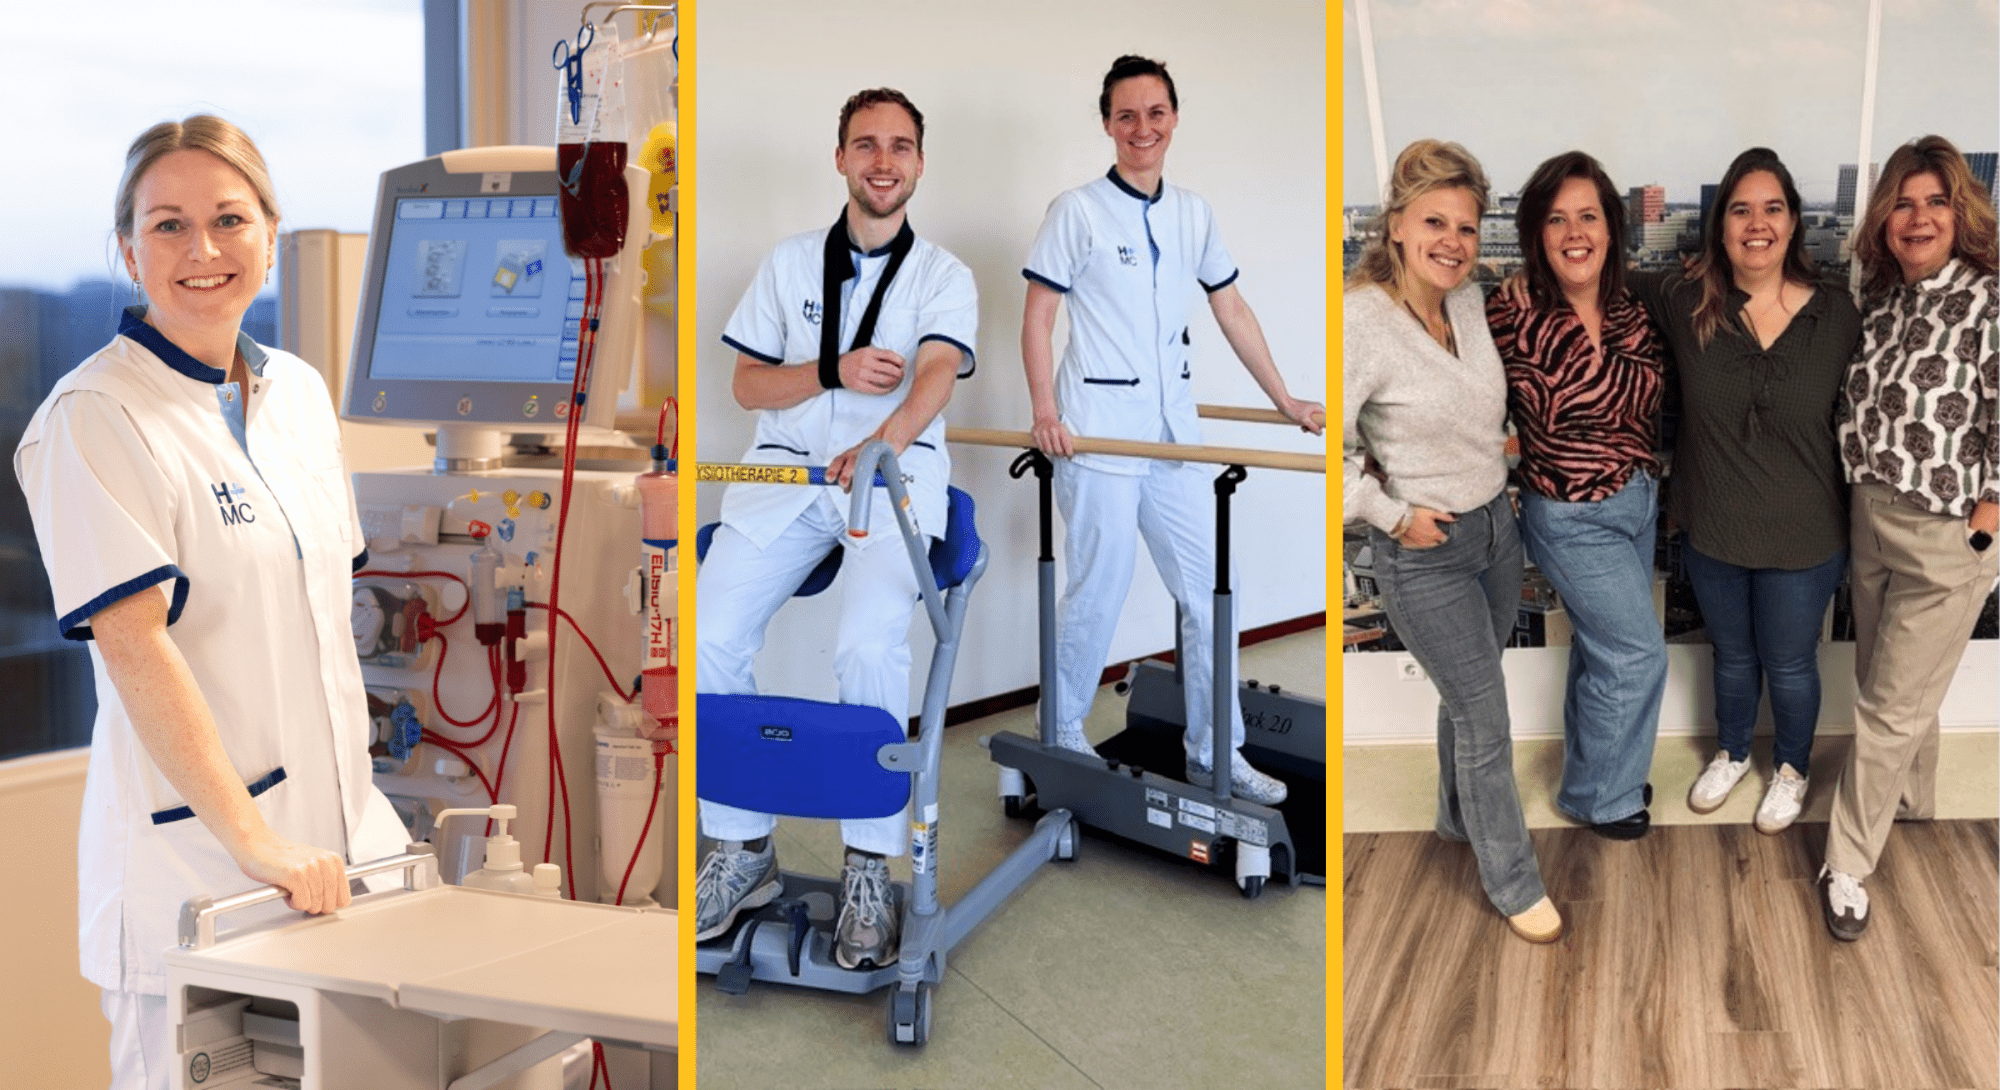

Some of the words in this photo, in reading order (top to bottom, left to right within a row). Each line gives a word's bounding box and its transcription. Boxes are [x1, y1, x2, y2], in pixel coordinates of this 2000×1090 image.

[1119, 255, 1138, 267] MC
[790, 469, 798, 484] 2
[220, 503, 255, 526] MC
[1242, 707, 1265, 729] ack
[1268, 715, 1293, 735] 2.0
